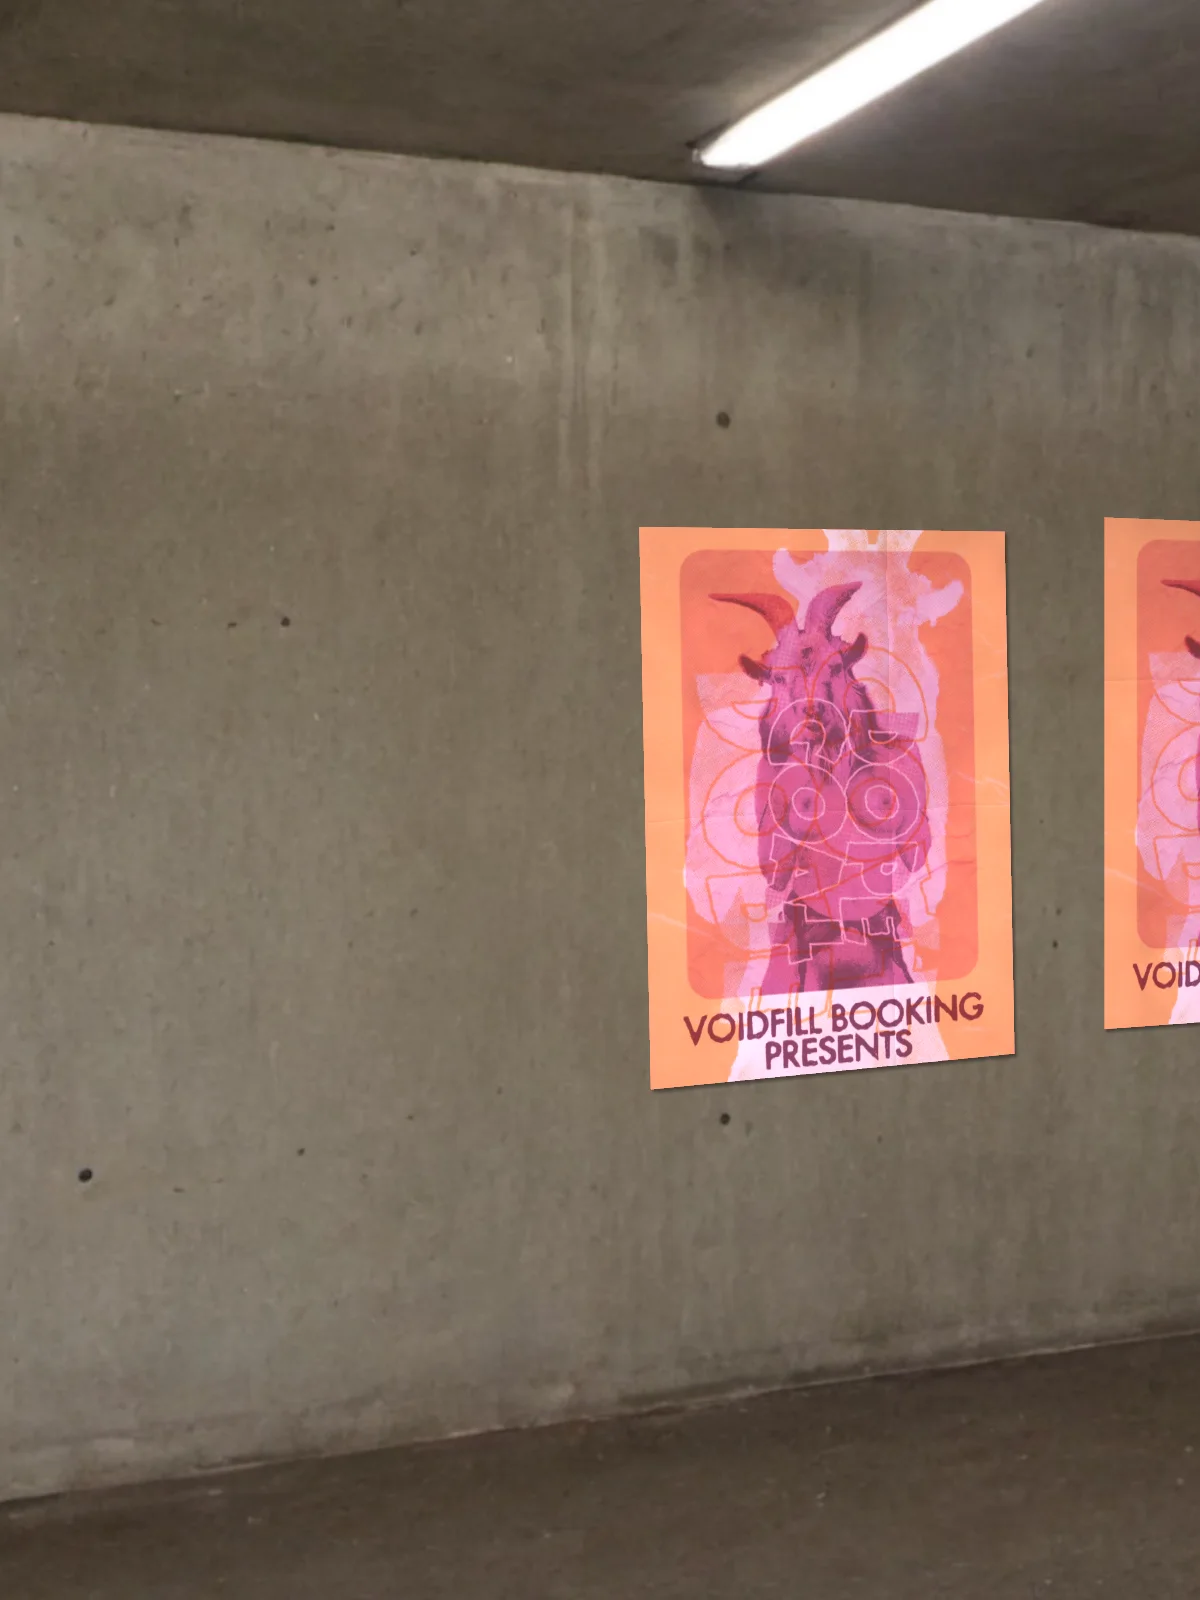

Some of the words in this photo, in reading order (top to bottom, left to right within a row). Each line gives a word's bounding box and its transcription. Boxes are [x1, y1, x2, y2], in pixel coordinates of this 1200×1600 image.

[840, 708, 919, 946] DOPE
[683, 1005, 824, 1046] VOIDFILL
[831, 992, 985, 1033] BOOKING
[764, 1029, 913, 1070] PRESENTS
